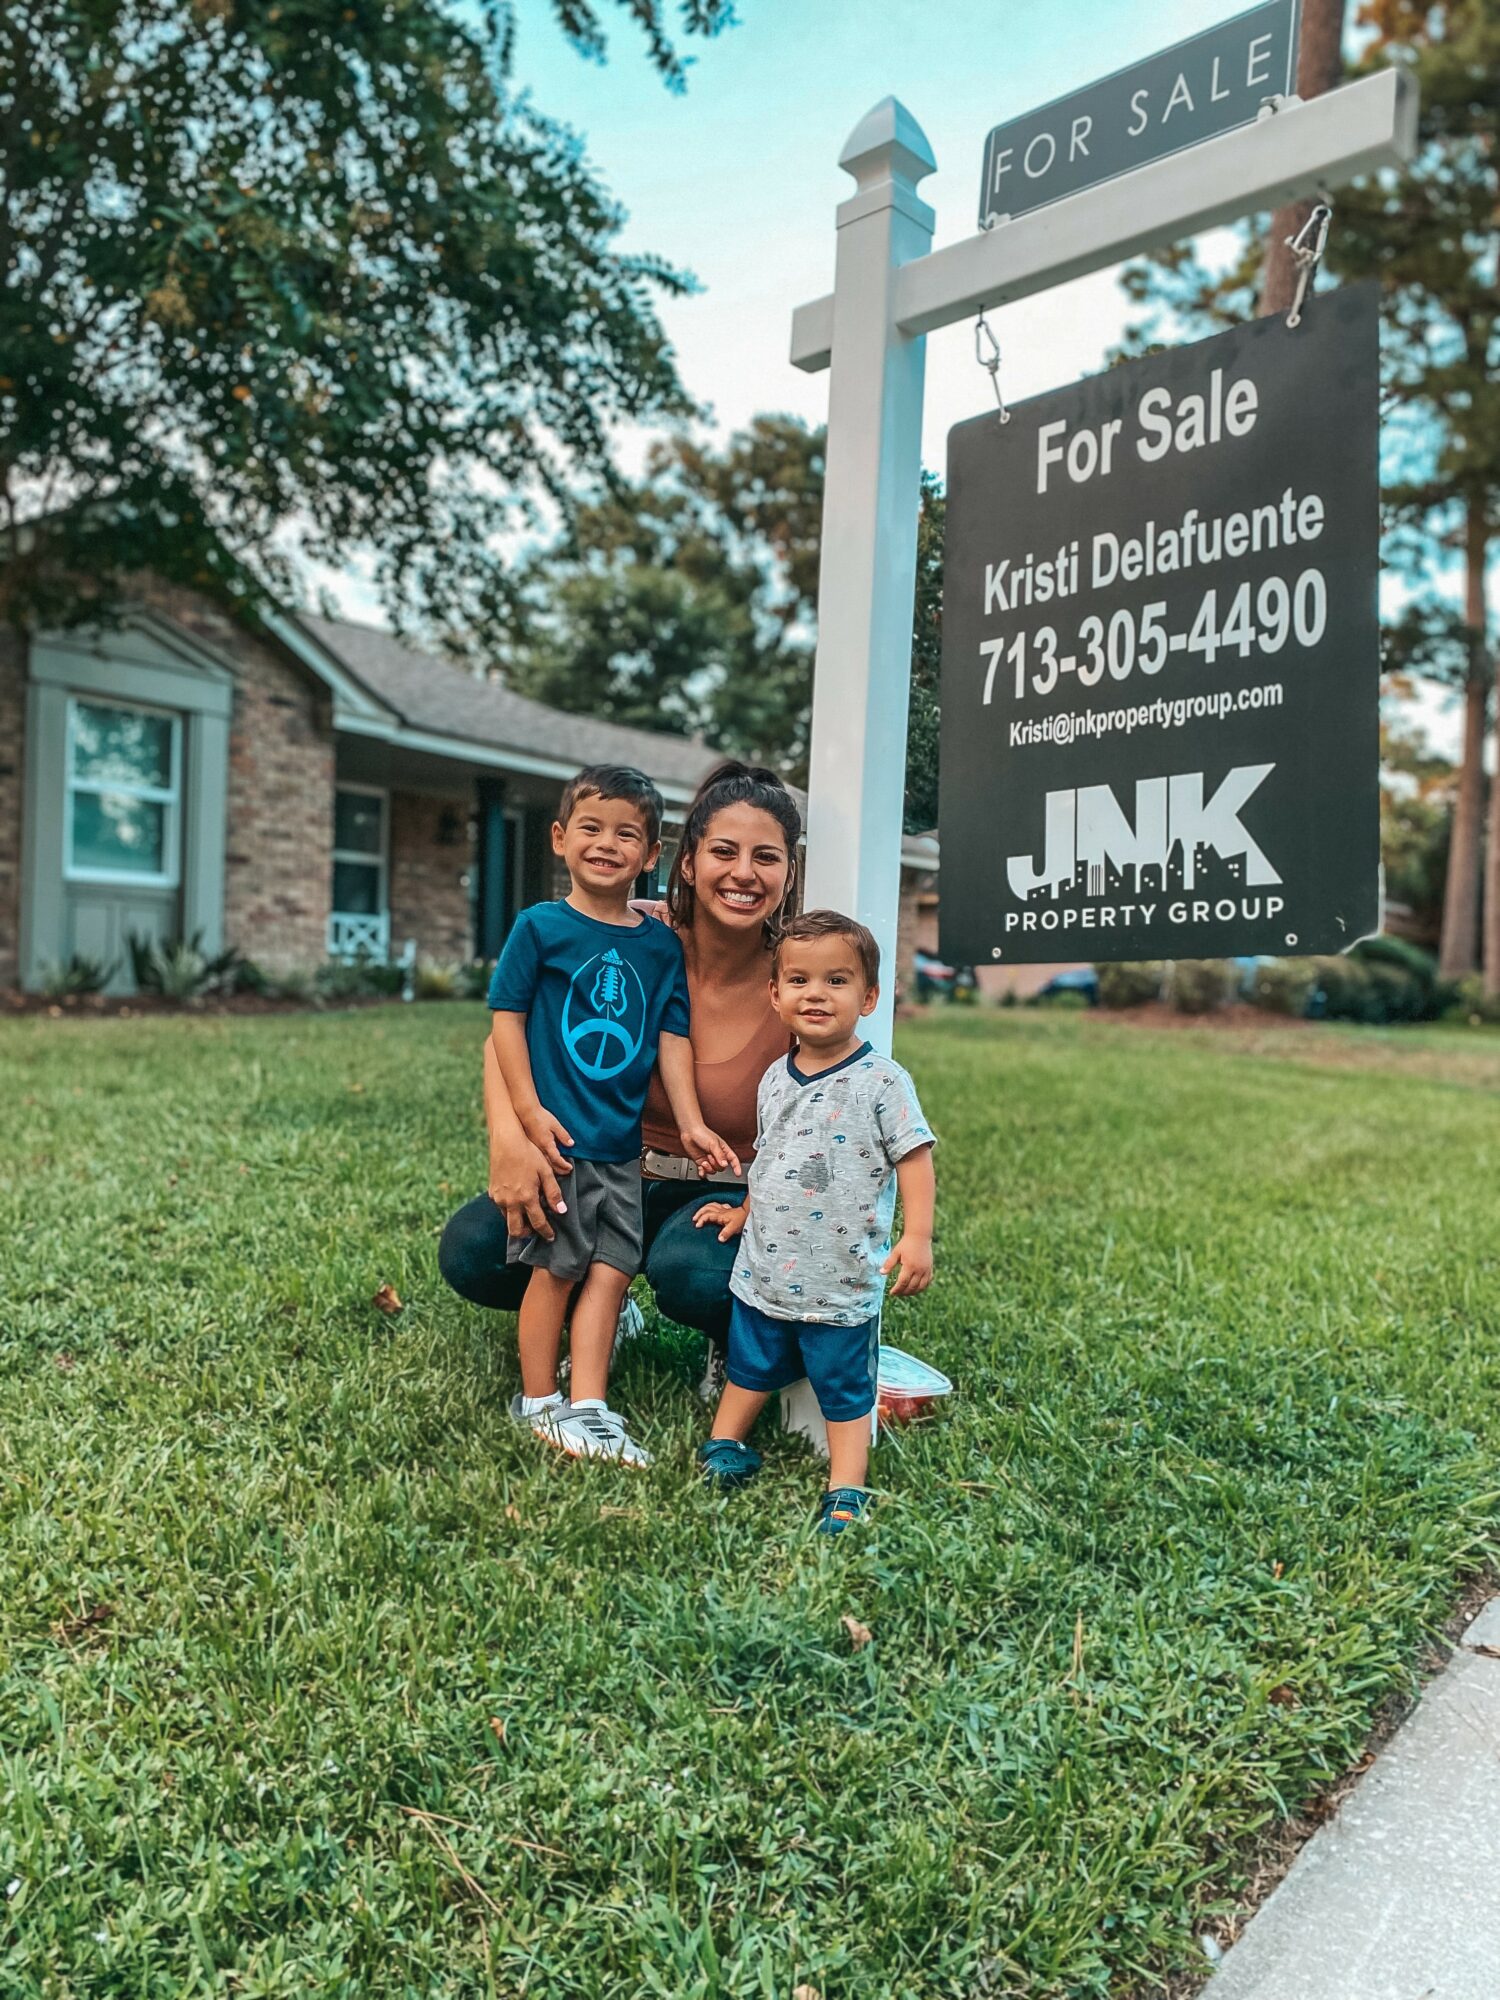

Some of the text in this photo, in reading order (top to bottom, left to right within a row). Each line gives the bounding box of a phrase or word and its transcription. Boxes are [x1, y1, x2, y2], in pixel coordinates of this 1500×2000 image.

[993, 33, 1273, 194] FOR SALE
[1037, 368, 1259, 494] For Sale
[984, 487, 1325, 616] Kristi Delafuente
[979, 568, 1327, 705] 713-305-4490
[1009, 683, 1283, 747] Kristi@jnkpropertygroup.com
[1006, 762, 1283, 901] JNK
[1005, 896, 1284, 931] PROPERTY GROUP
